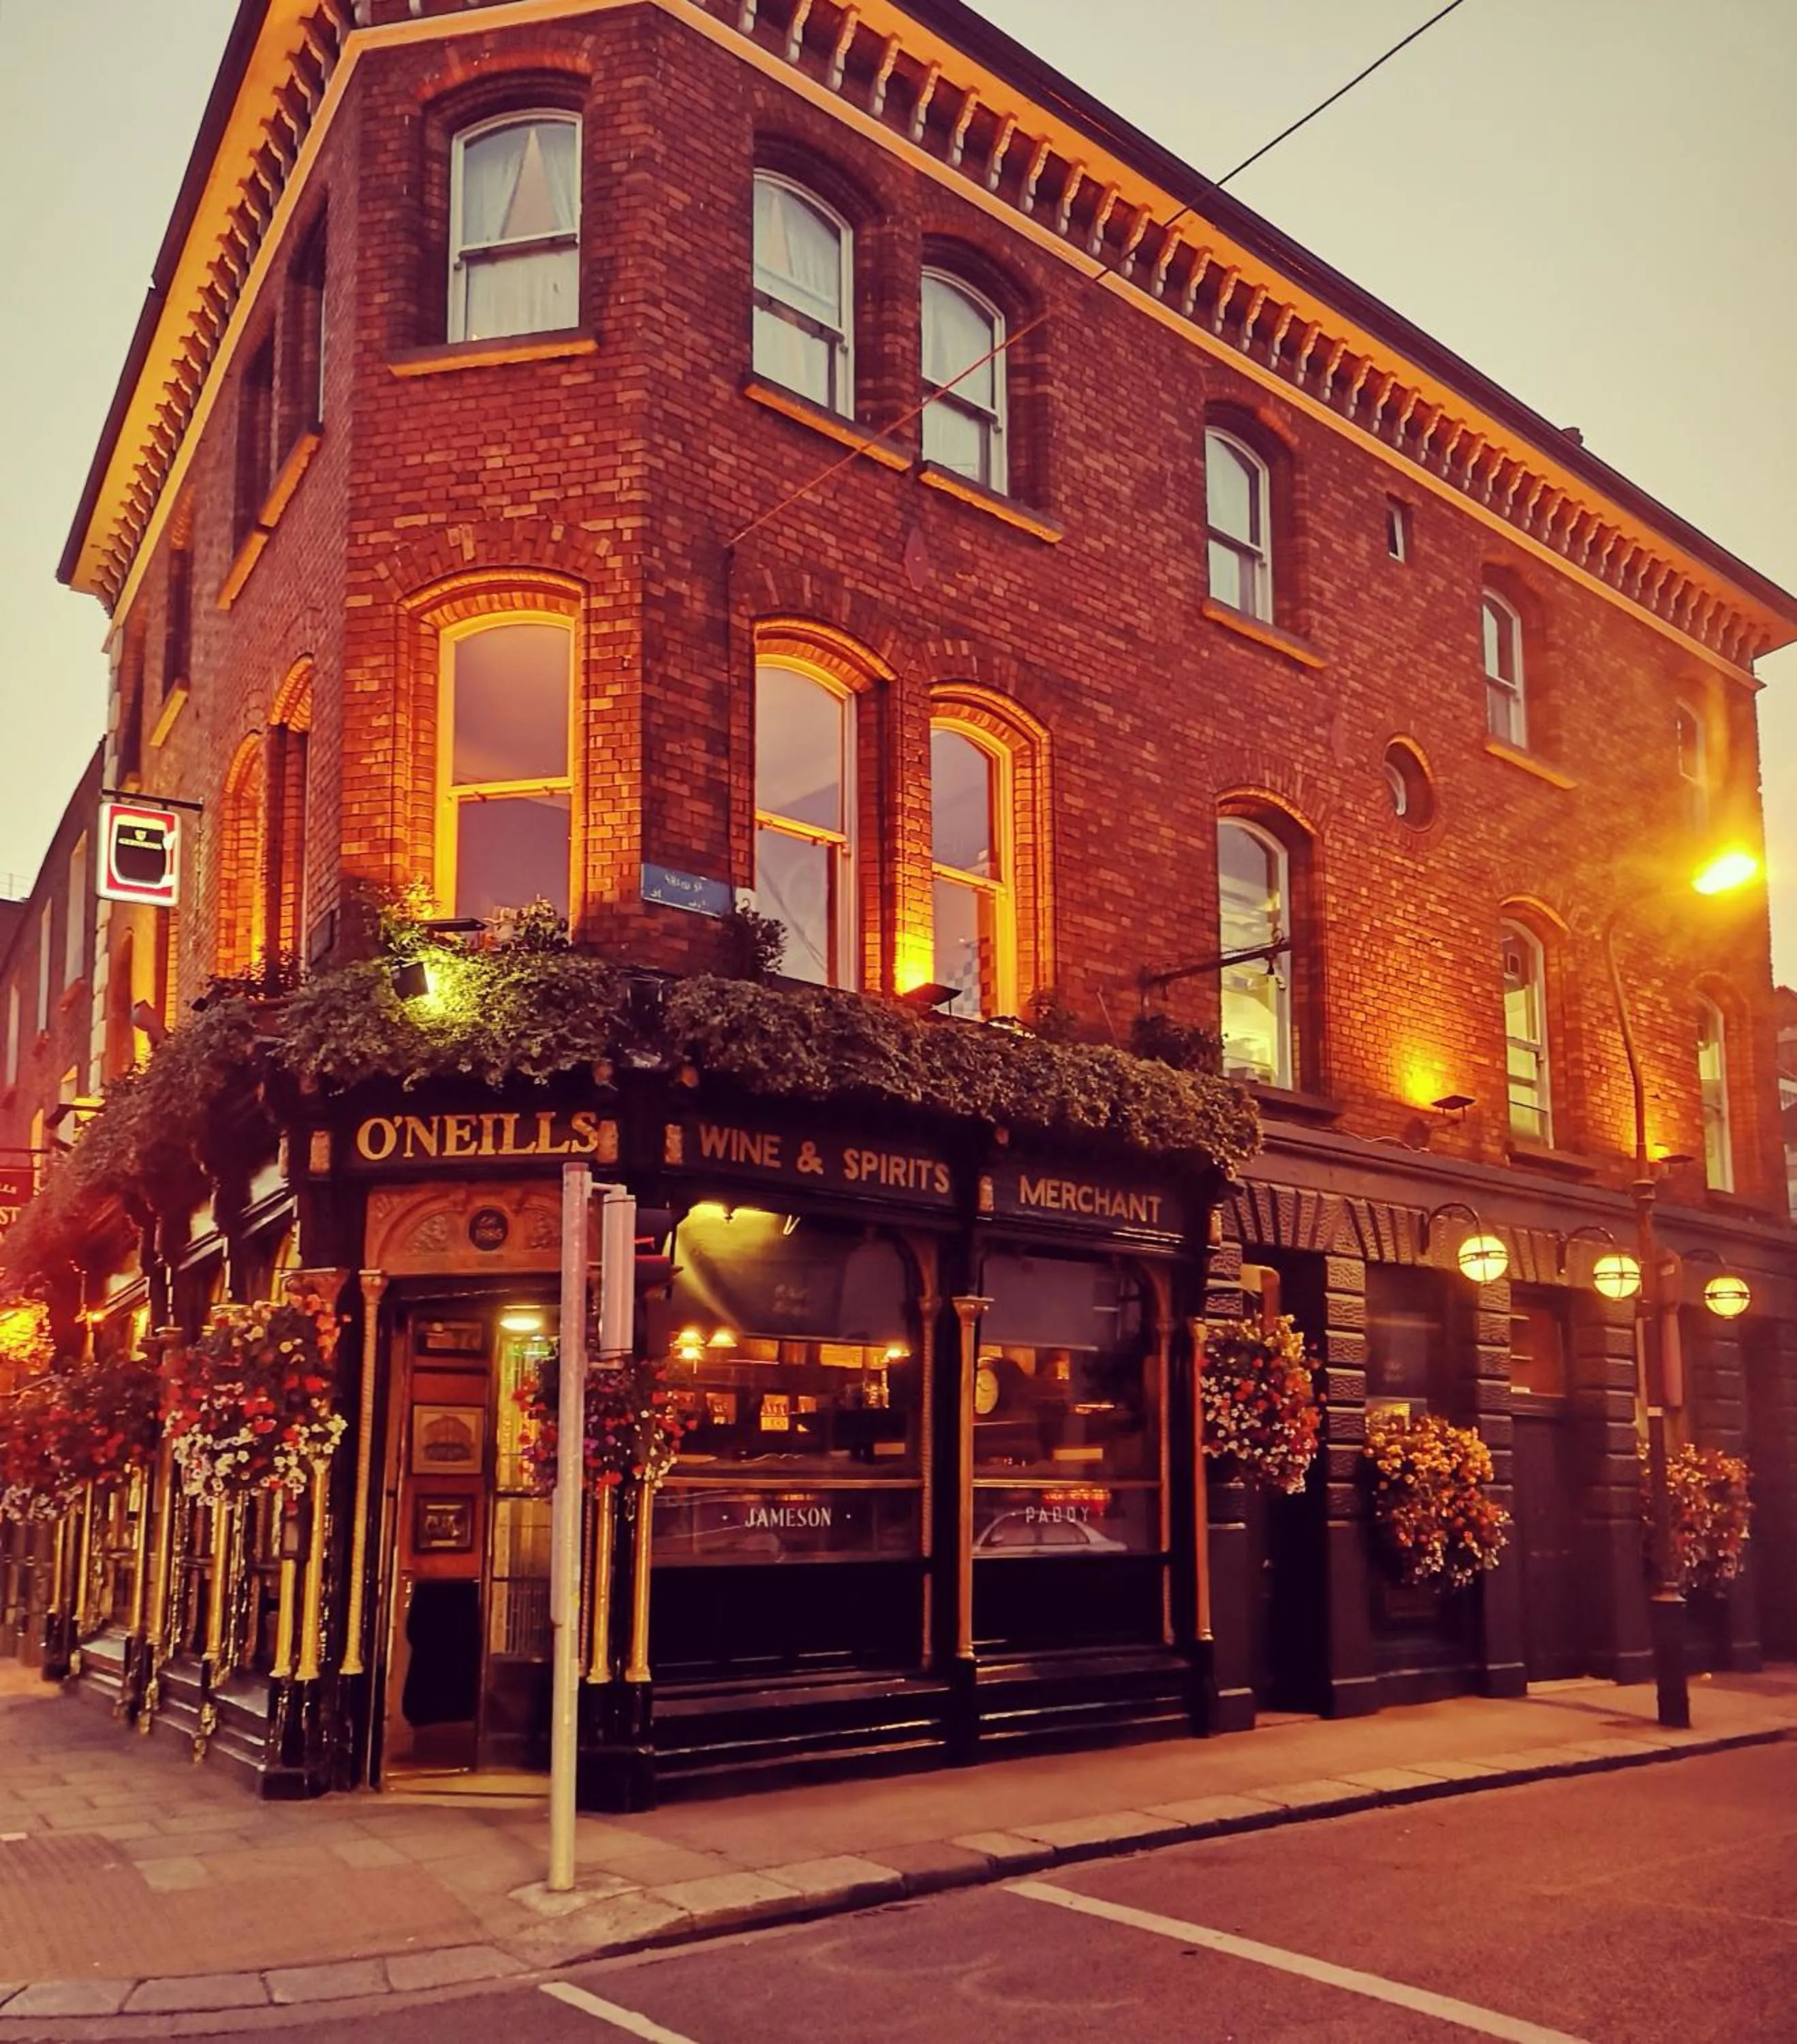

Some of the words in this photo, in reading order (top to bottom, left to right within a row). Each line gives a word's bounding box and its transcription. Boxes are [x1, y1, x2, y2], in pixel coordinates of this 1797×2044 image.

[356, 1111, 599, 1160] O'NEILLS
[699, 1123, 782, 1168] WINE
[796, 1140, 824, 1175] &
[843, 1147, 951, 1194] SPIRITS
[1019, 1174, 1162, 1223] MERCHANT
[745, 1506, 832, 1528] JAMESON
[1026, 1506, 1090, 1523] PADDY
